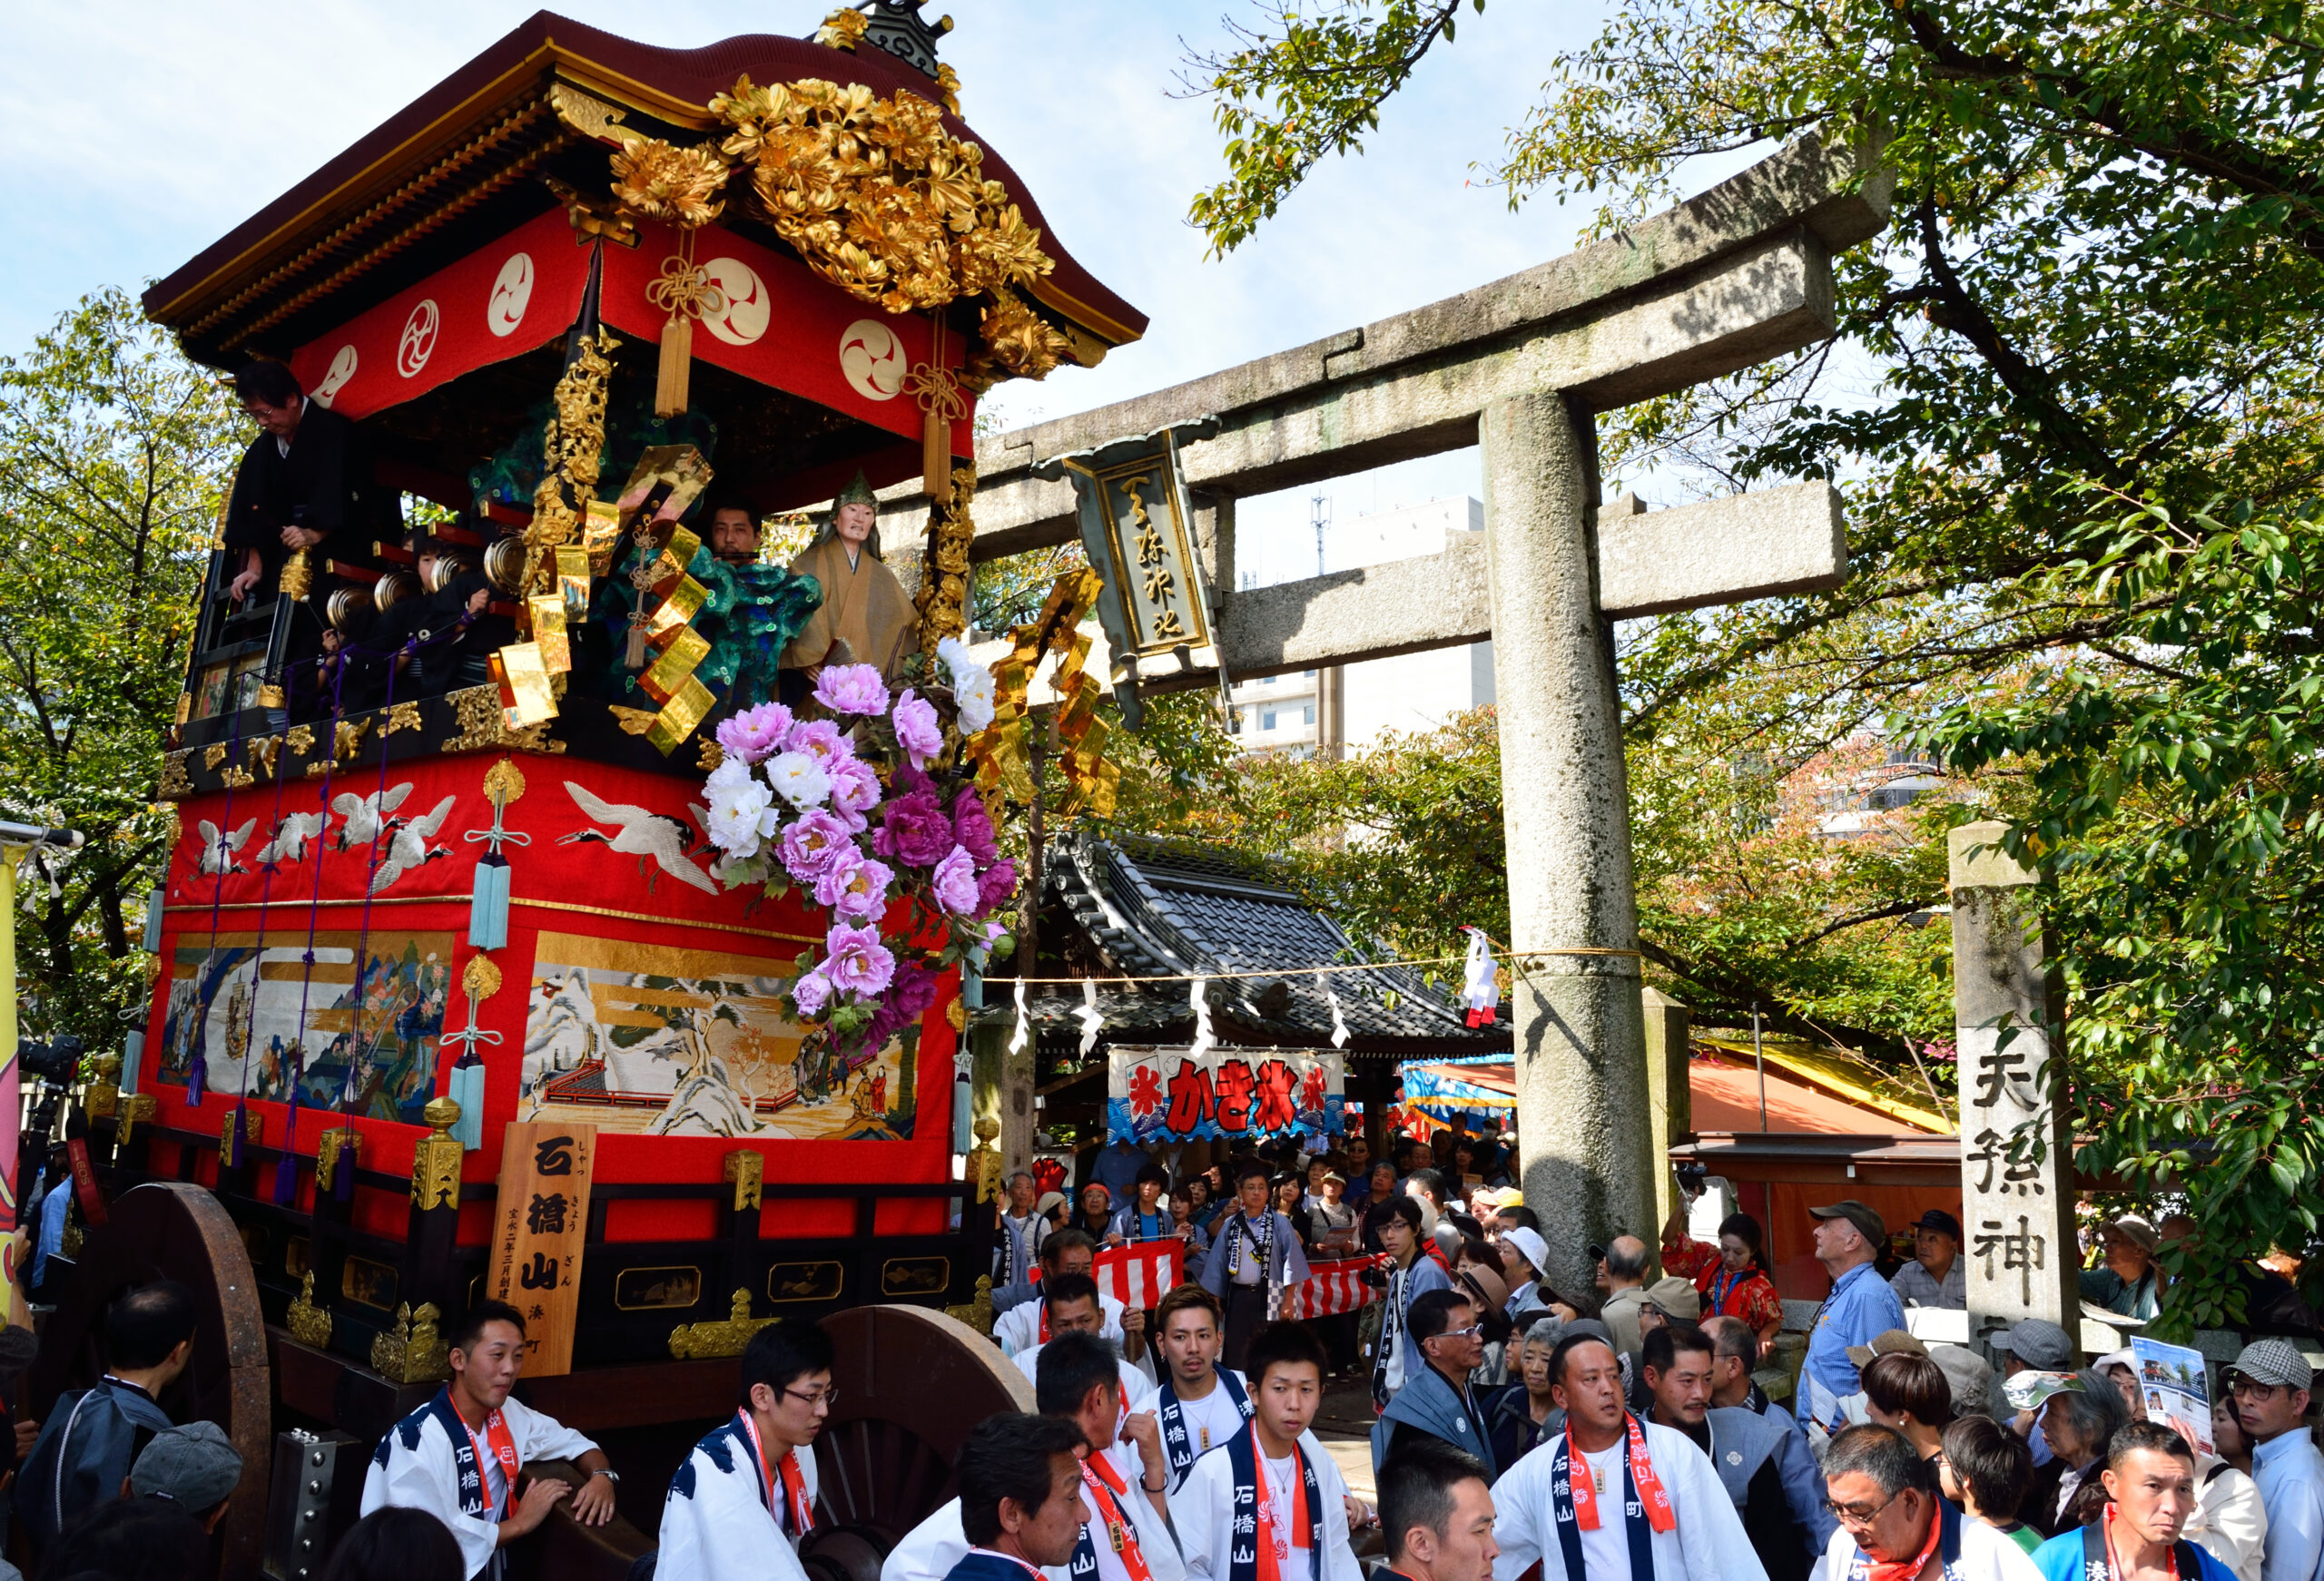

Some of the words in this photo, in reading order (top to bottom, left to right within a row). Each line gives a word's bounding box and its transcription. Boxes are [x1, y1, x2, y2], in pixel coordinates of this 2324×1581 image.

[1128, 1065, 1162, 1115] 氷
[1166, 1058, 1298, 1134] かき氷
[75, 1161, 91, 1185] EOS
[520, 1135, 575, 1291] 石橋山
[1163, 1403, 1192, 1468] 石橋山
[456, 1446, 483, 1515] 石橋山
[1552, 1455, 1574, 1523] 石橋山
[1233, 1485, 1256, 1564] 石橋山
